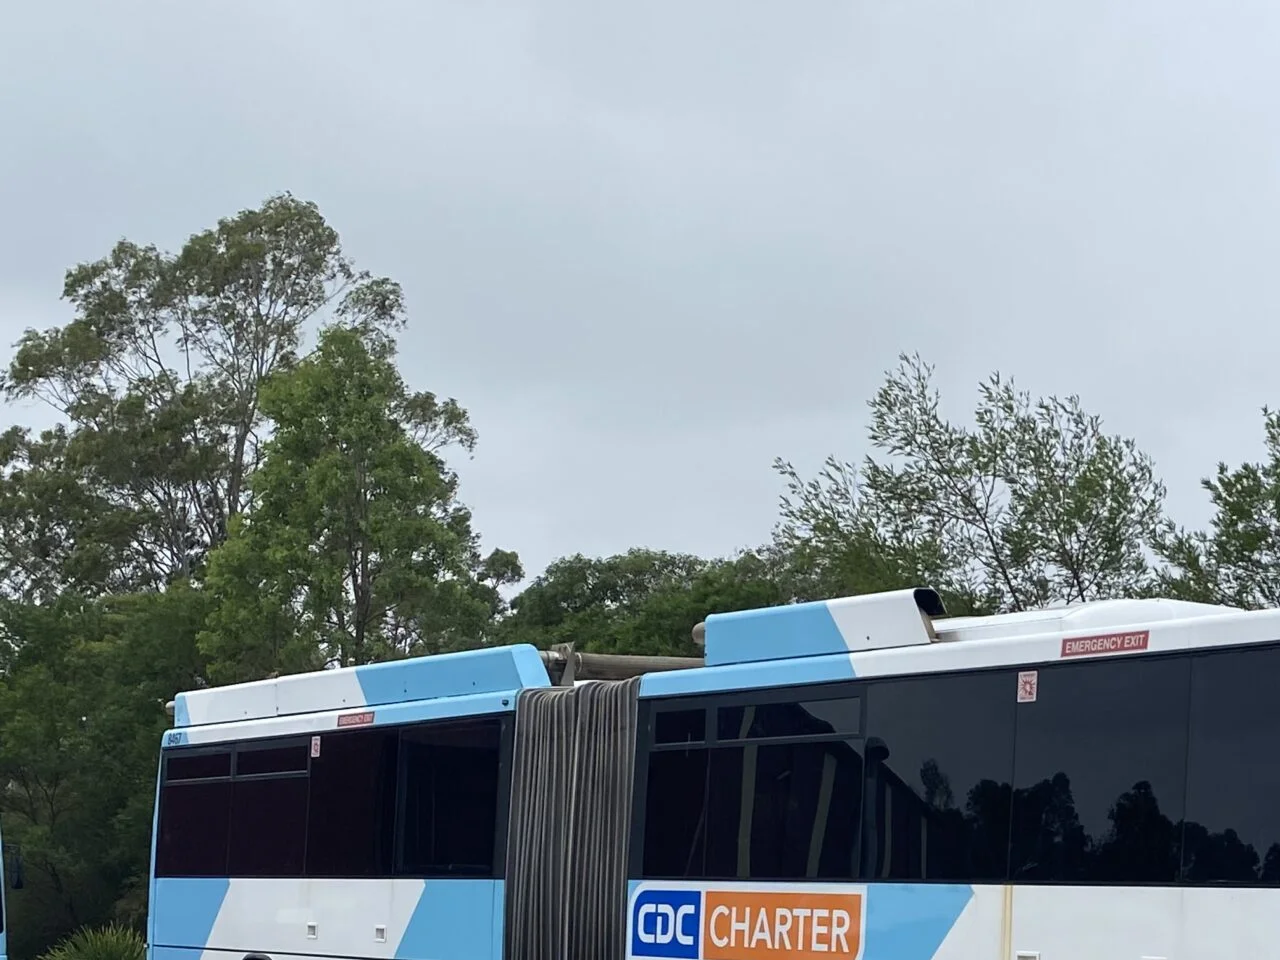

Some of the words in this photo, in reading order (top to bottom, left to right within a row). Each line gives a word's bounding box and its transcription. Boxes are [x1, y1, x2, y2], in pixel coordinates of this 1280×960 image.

[1065, 637, 1123, 653] EMERGENCY
[1123, 634, 1146, 648] EXIT
[637, 903, 696, 945] CDC
[709, 905, 850, 953] CHARTER
